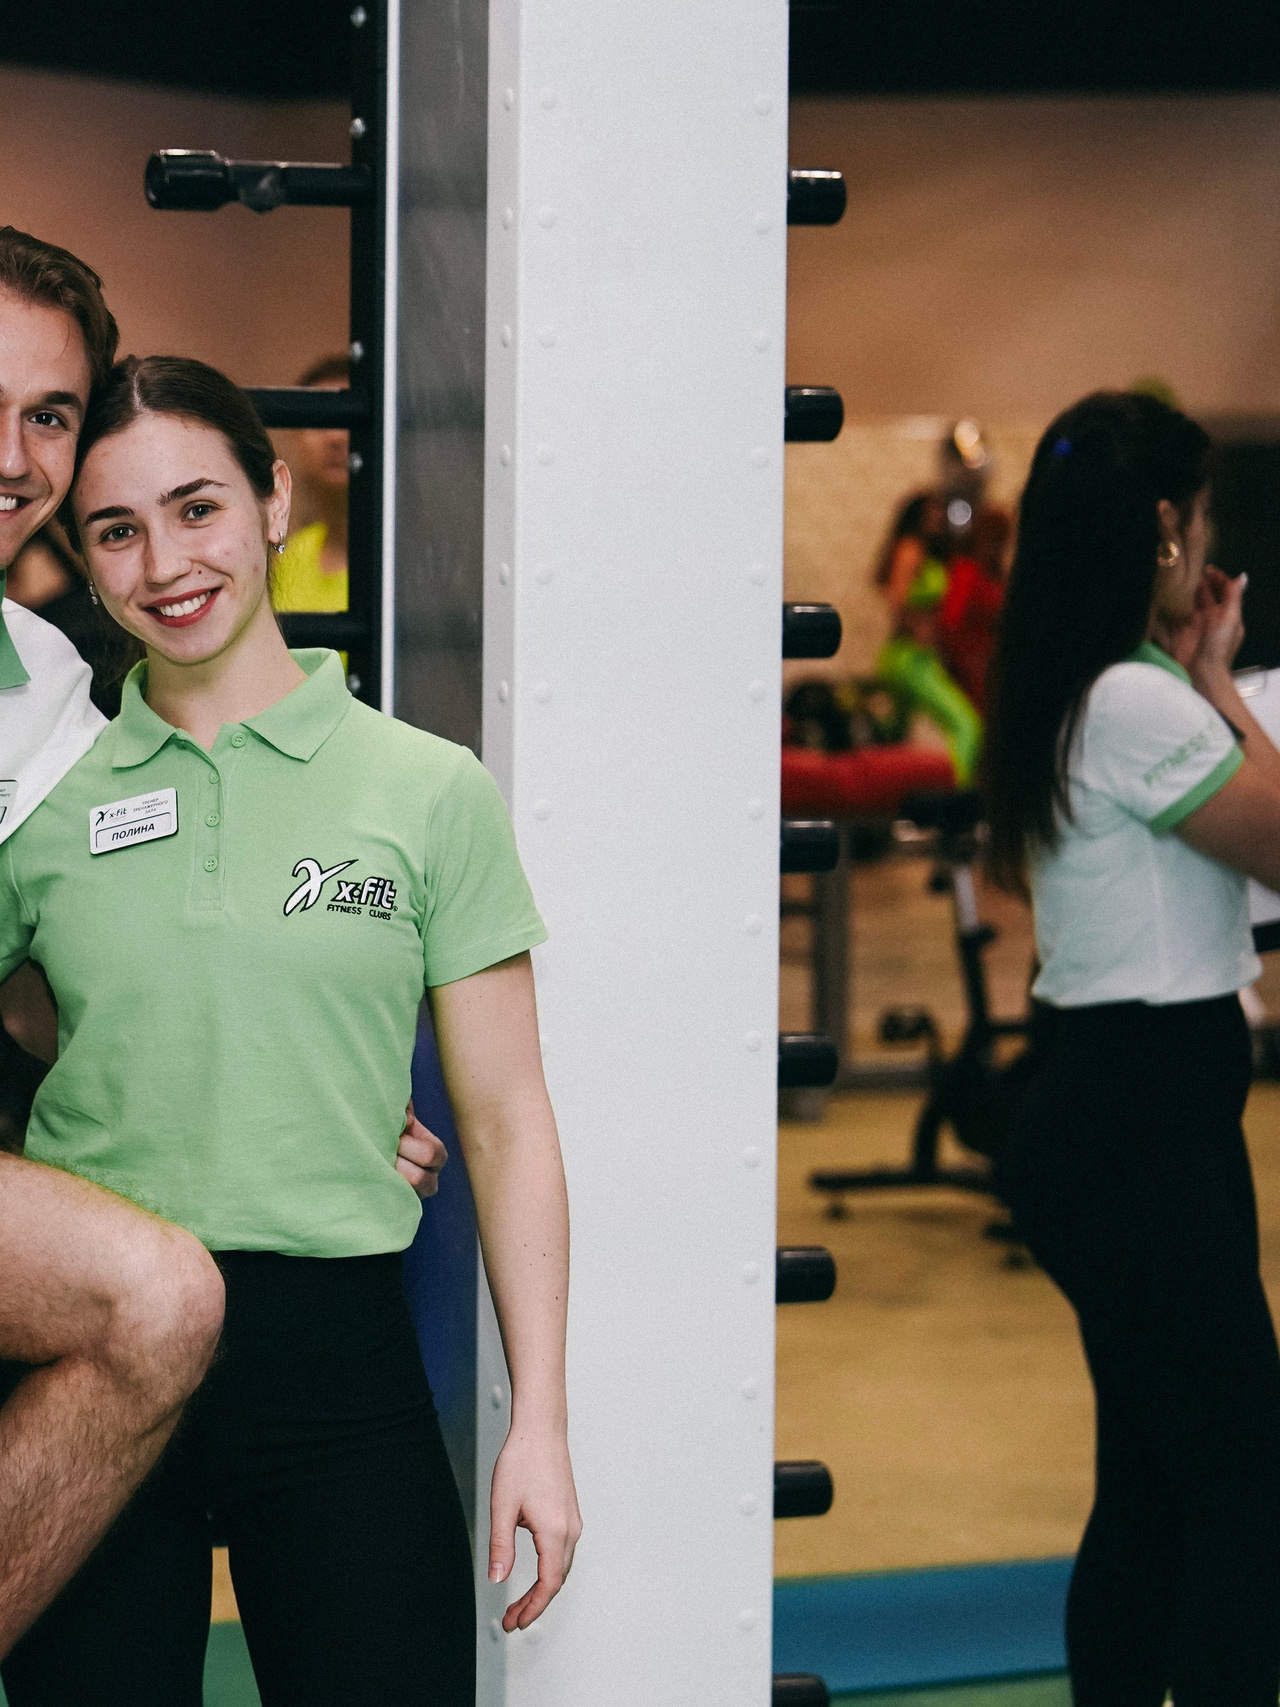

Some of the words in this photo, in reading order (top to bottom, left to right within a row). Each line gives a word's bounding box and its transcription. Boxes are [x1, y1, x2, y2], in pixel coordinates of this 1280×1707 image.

[111, 822, 155, 841] ПОЛИНА
[326, 903, 362, 915] FITNESS
[368, 908, 392, 921] CLUBS
